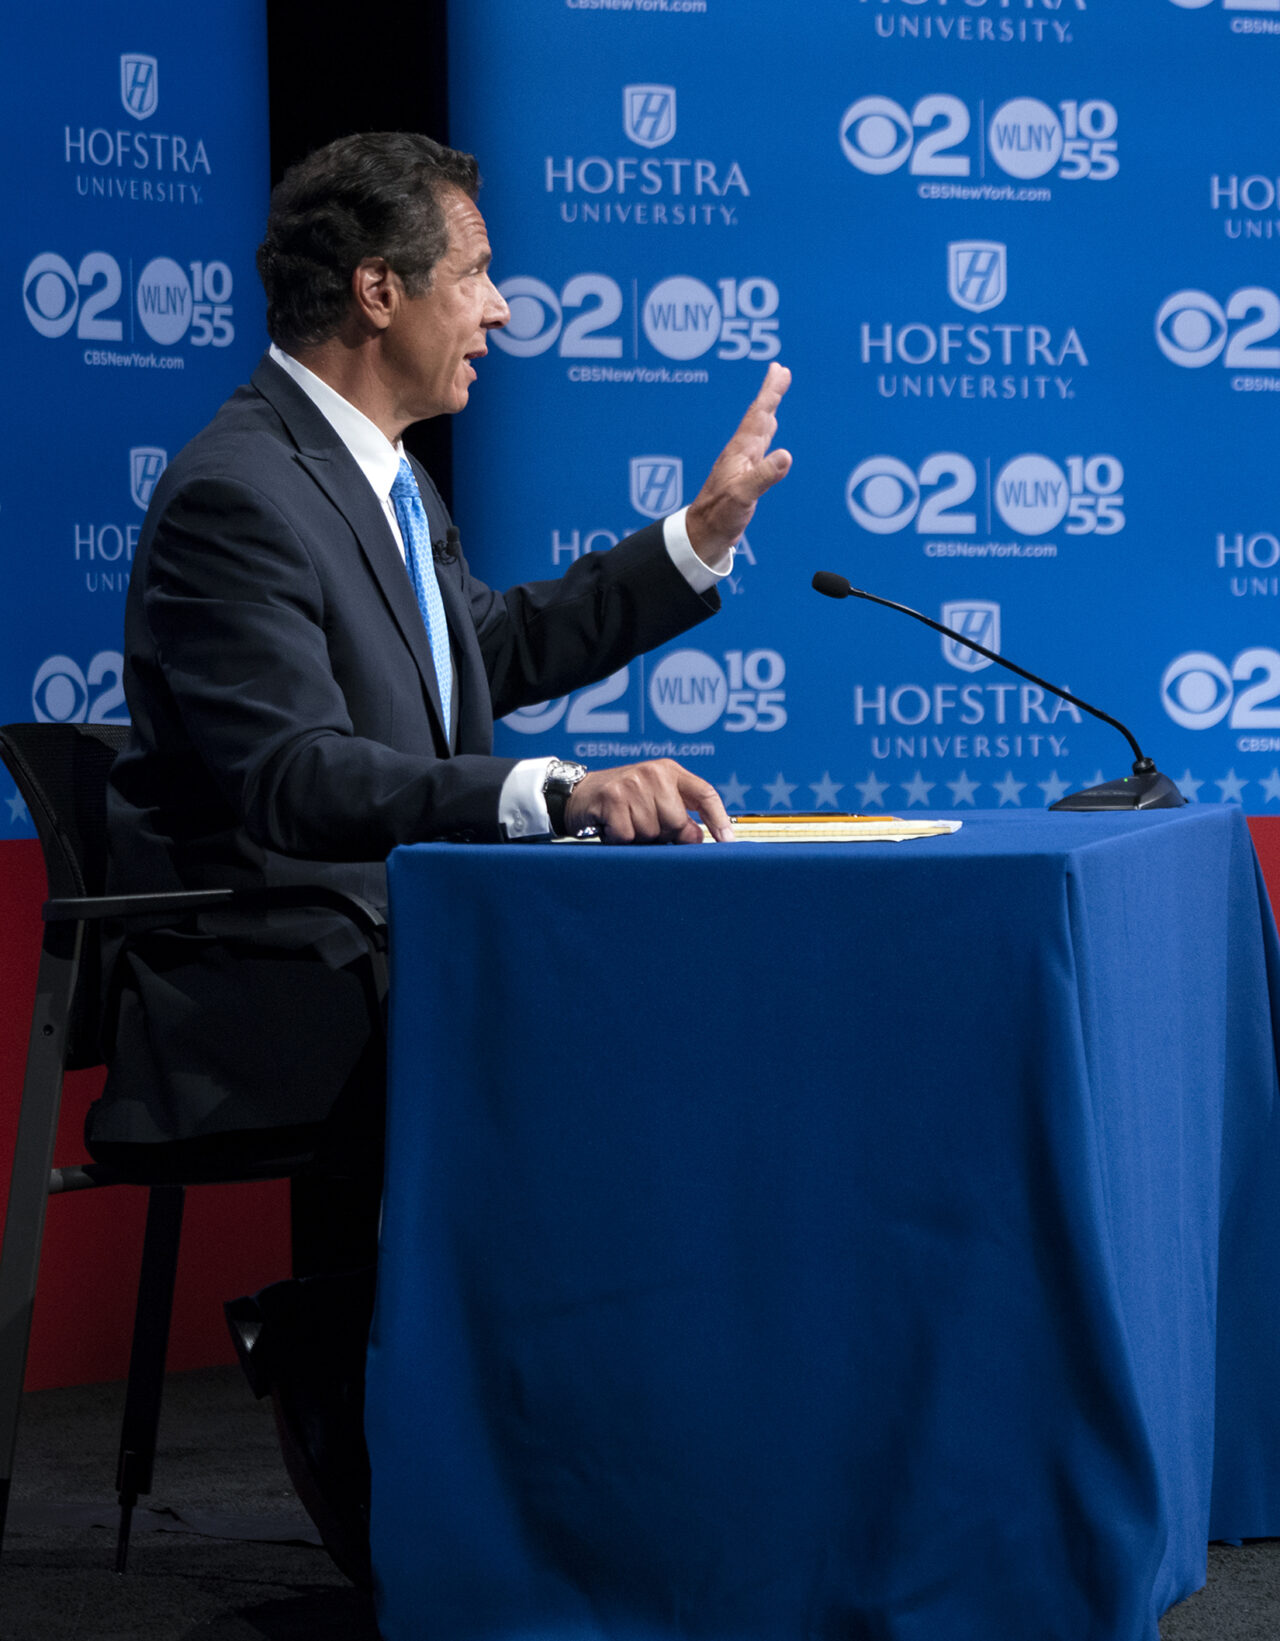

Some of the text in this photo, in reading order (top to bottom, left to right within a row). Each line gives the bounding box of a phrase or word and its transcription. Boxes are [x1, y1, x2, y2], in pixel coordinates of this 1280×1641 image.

[910, 94, 1056, 176] 2 WLNY
[1058, 101, 1117, 141] 10
[65, 126, 211, 174] HOFSTRA
[1058, 140, 1119, 180] 55
[546, 157, 750, 196] HOFSTRA
[918, 183, 1051, 201] CBSNewYork.com
[78, 252, 188, 340] 2 WLNY
[189, 261, 232, 303] 10
[717, 278, 779, 319] 10
[189, 302, 234, 347] 55
[560, 273, 710, 358] 2 WLNY
[84, 350, 184, 369] CBSNewYork.com
[717, 318, 781, 360] 55
[861, 323, 1088, 366] HOFSTRA
[568, 366, 708, 383] CBSNewYork.com
[917, 452, 1061, 533] 2 WLNY
[1064, 456, 1123, 496] 10
[1064, 495, 1125, 534] 55
[924, 542, 1057, 557] CBSNewYork.com
[657, 677, 720, 706] WLNY
[722, 650, 785, 692] 10
[722, 689, 787, 732] 55
[855, 684, 1082, 725] HOFSTRA
[574, 741, 715, 757] CBSNewYork.com
